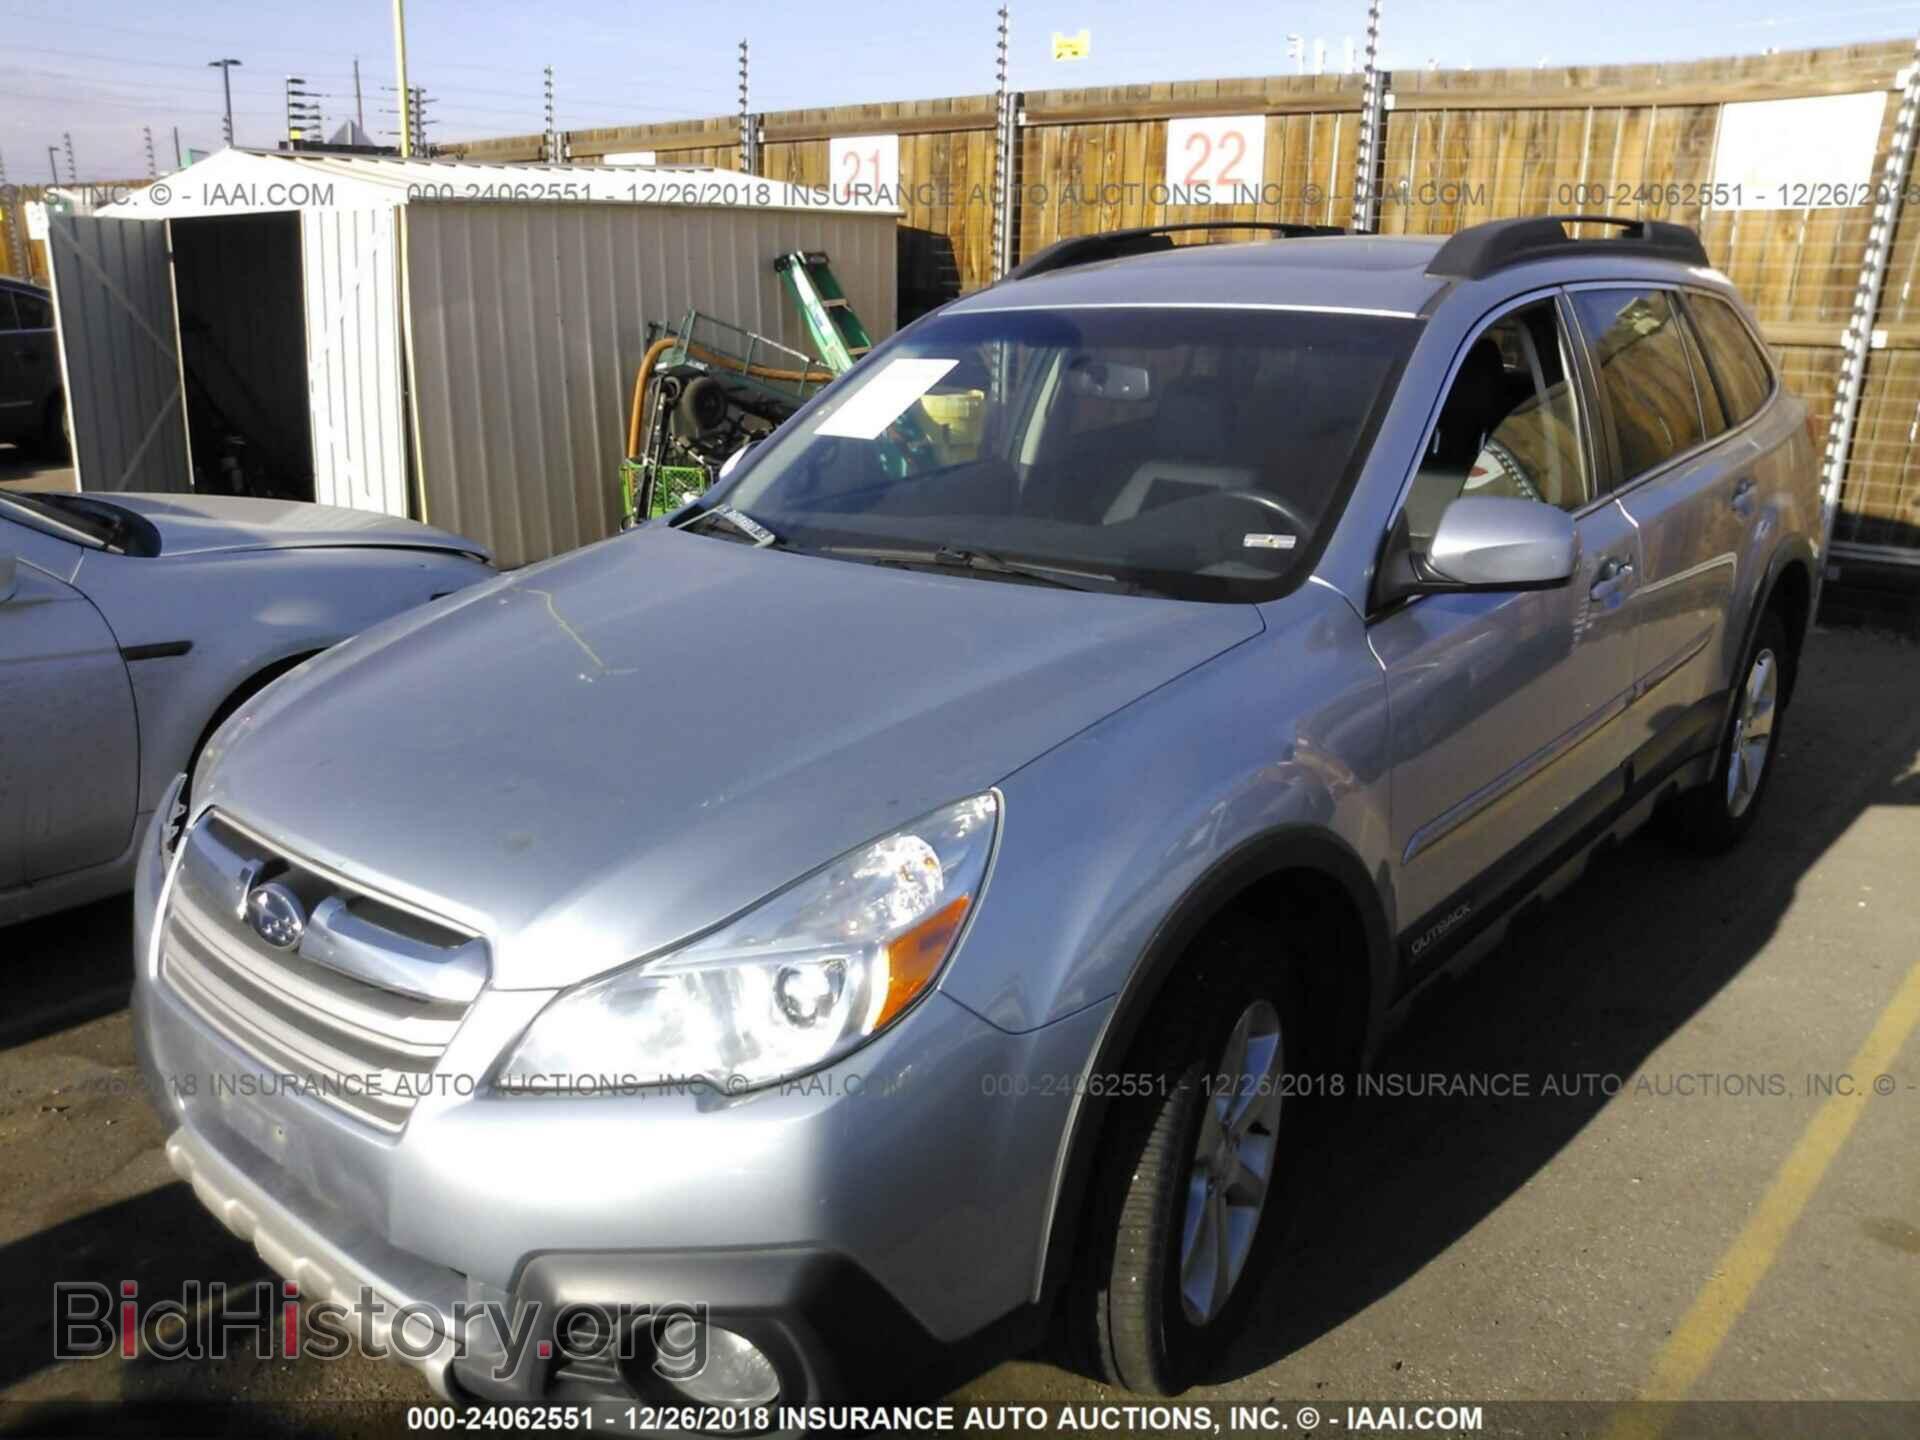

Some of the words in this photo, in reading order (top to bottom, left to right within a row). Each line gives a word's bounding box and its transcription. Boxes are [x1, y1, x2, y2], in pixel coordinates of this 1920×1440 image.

[842, 148, 881, 198] 21
[1184, 131, 1246, 186] 22
[1411, 902, 1472, 955] OUTBACK
